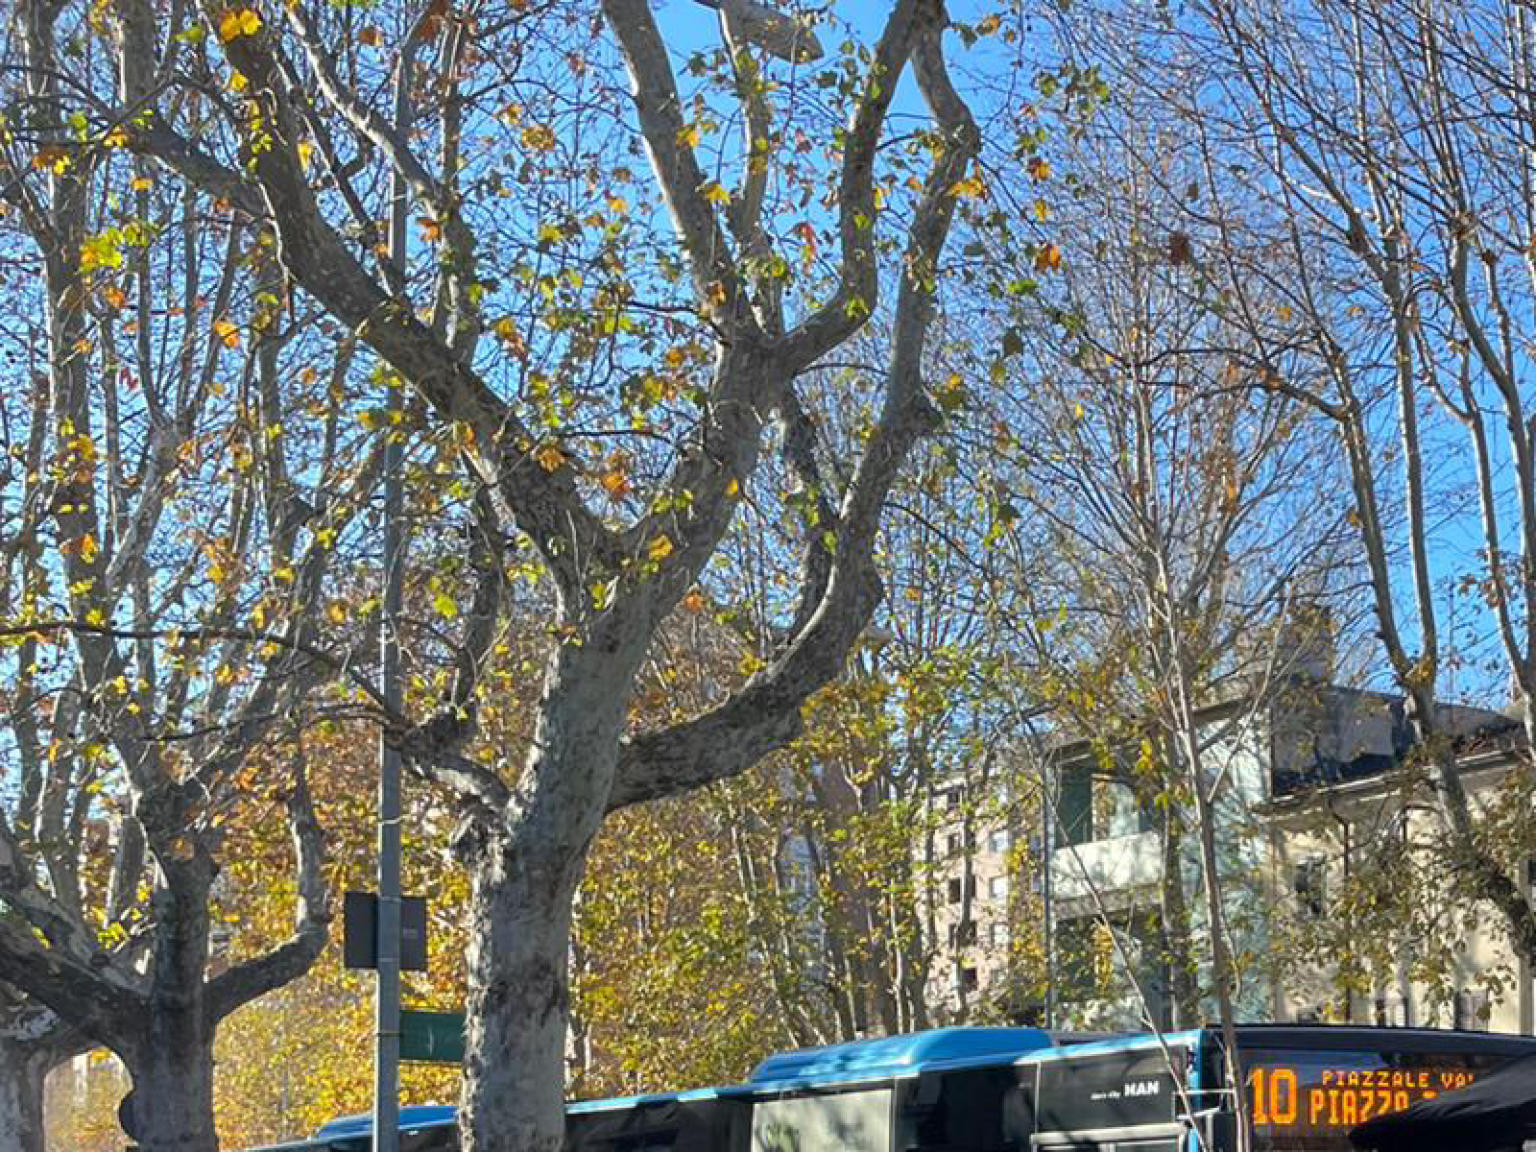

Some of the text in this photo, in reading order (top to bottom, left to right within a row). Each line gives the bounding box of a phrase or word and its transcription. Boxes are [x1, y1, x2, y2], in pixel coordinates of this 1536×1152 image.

[1322, 1070, 1430, 1087] PIAZZALE
[1124, 1080, 1160, 1097] MAN
[1250, 1067, 1299, 1125] 10
